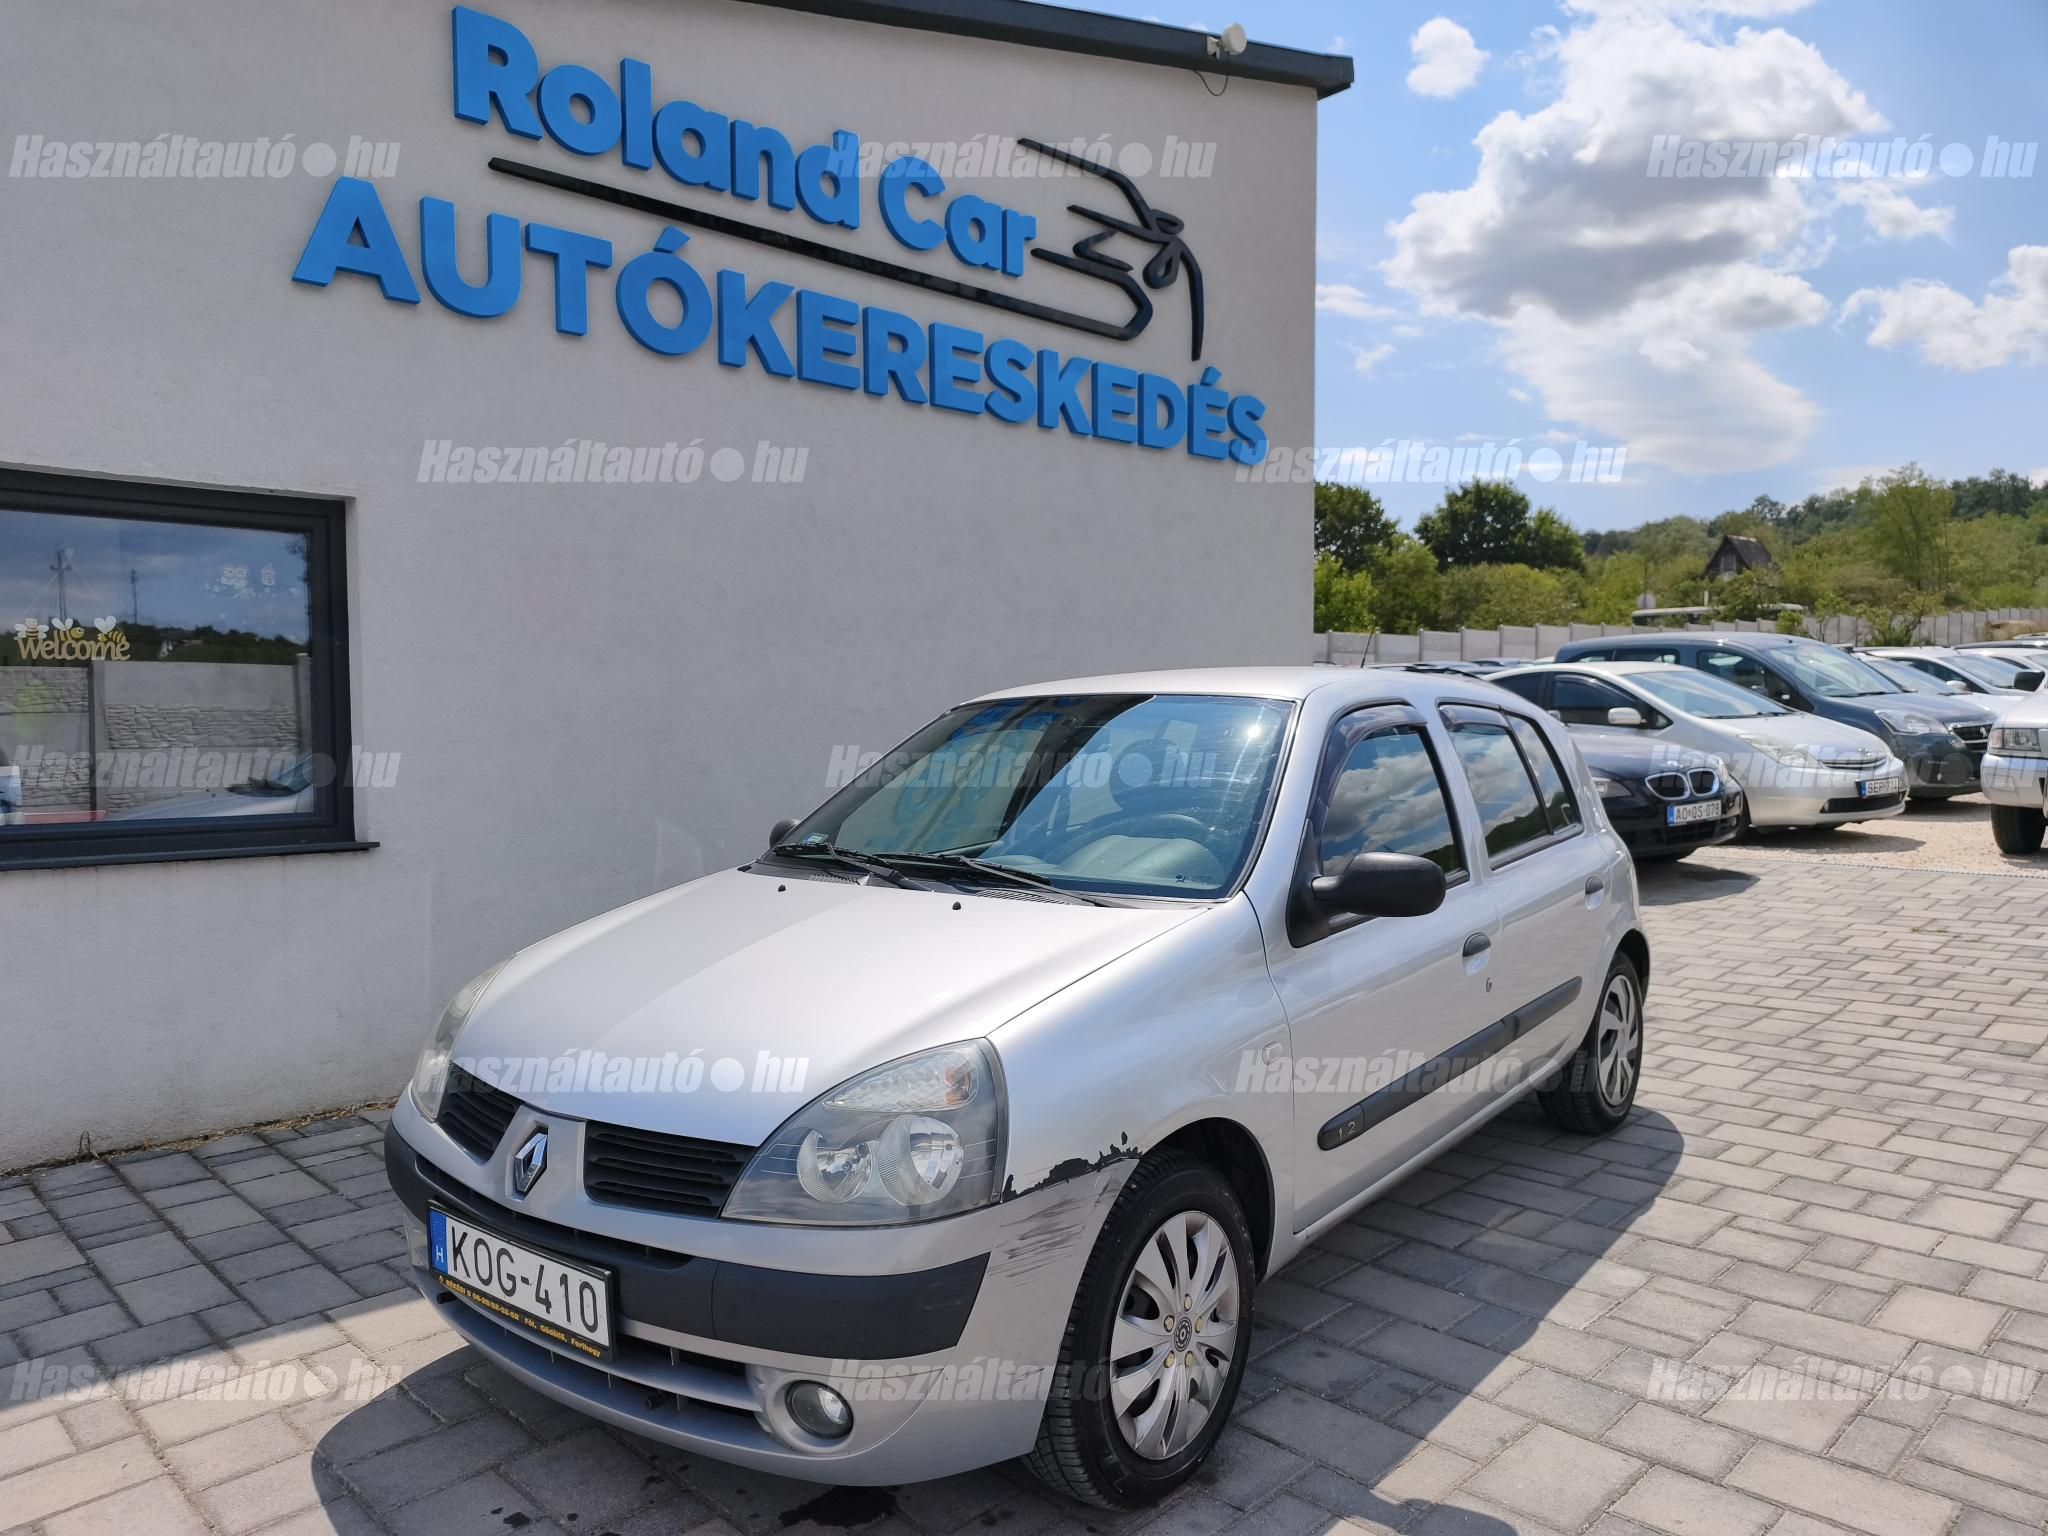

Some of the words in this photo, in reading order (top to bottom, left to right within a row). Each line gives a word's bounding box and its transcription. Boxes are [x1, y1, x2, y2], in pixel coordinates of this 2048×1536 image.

[451, 5, 860, 230] Roland
[878, 155, 1037, 277] Car
[291, 175, 1270, 467] AUTÓKERESKEDÉS
[14, 629, 131, 661] Welcome
[435, 1246, 444, 1264] H
[451, 1226, 599, 1334] KOG-410
